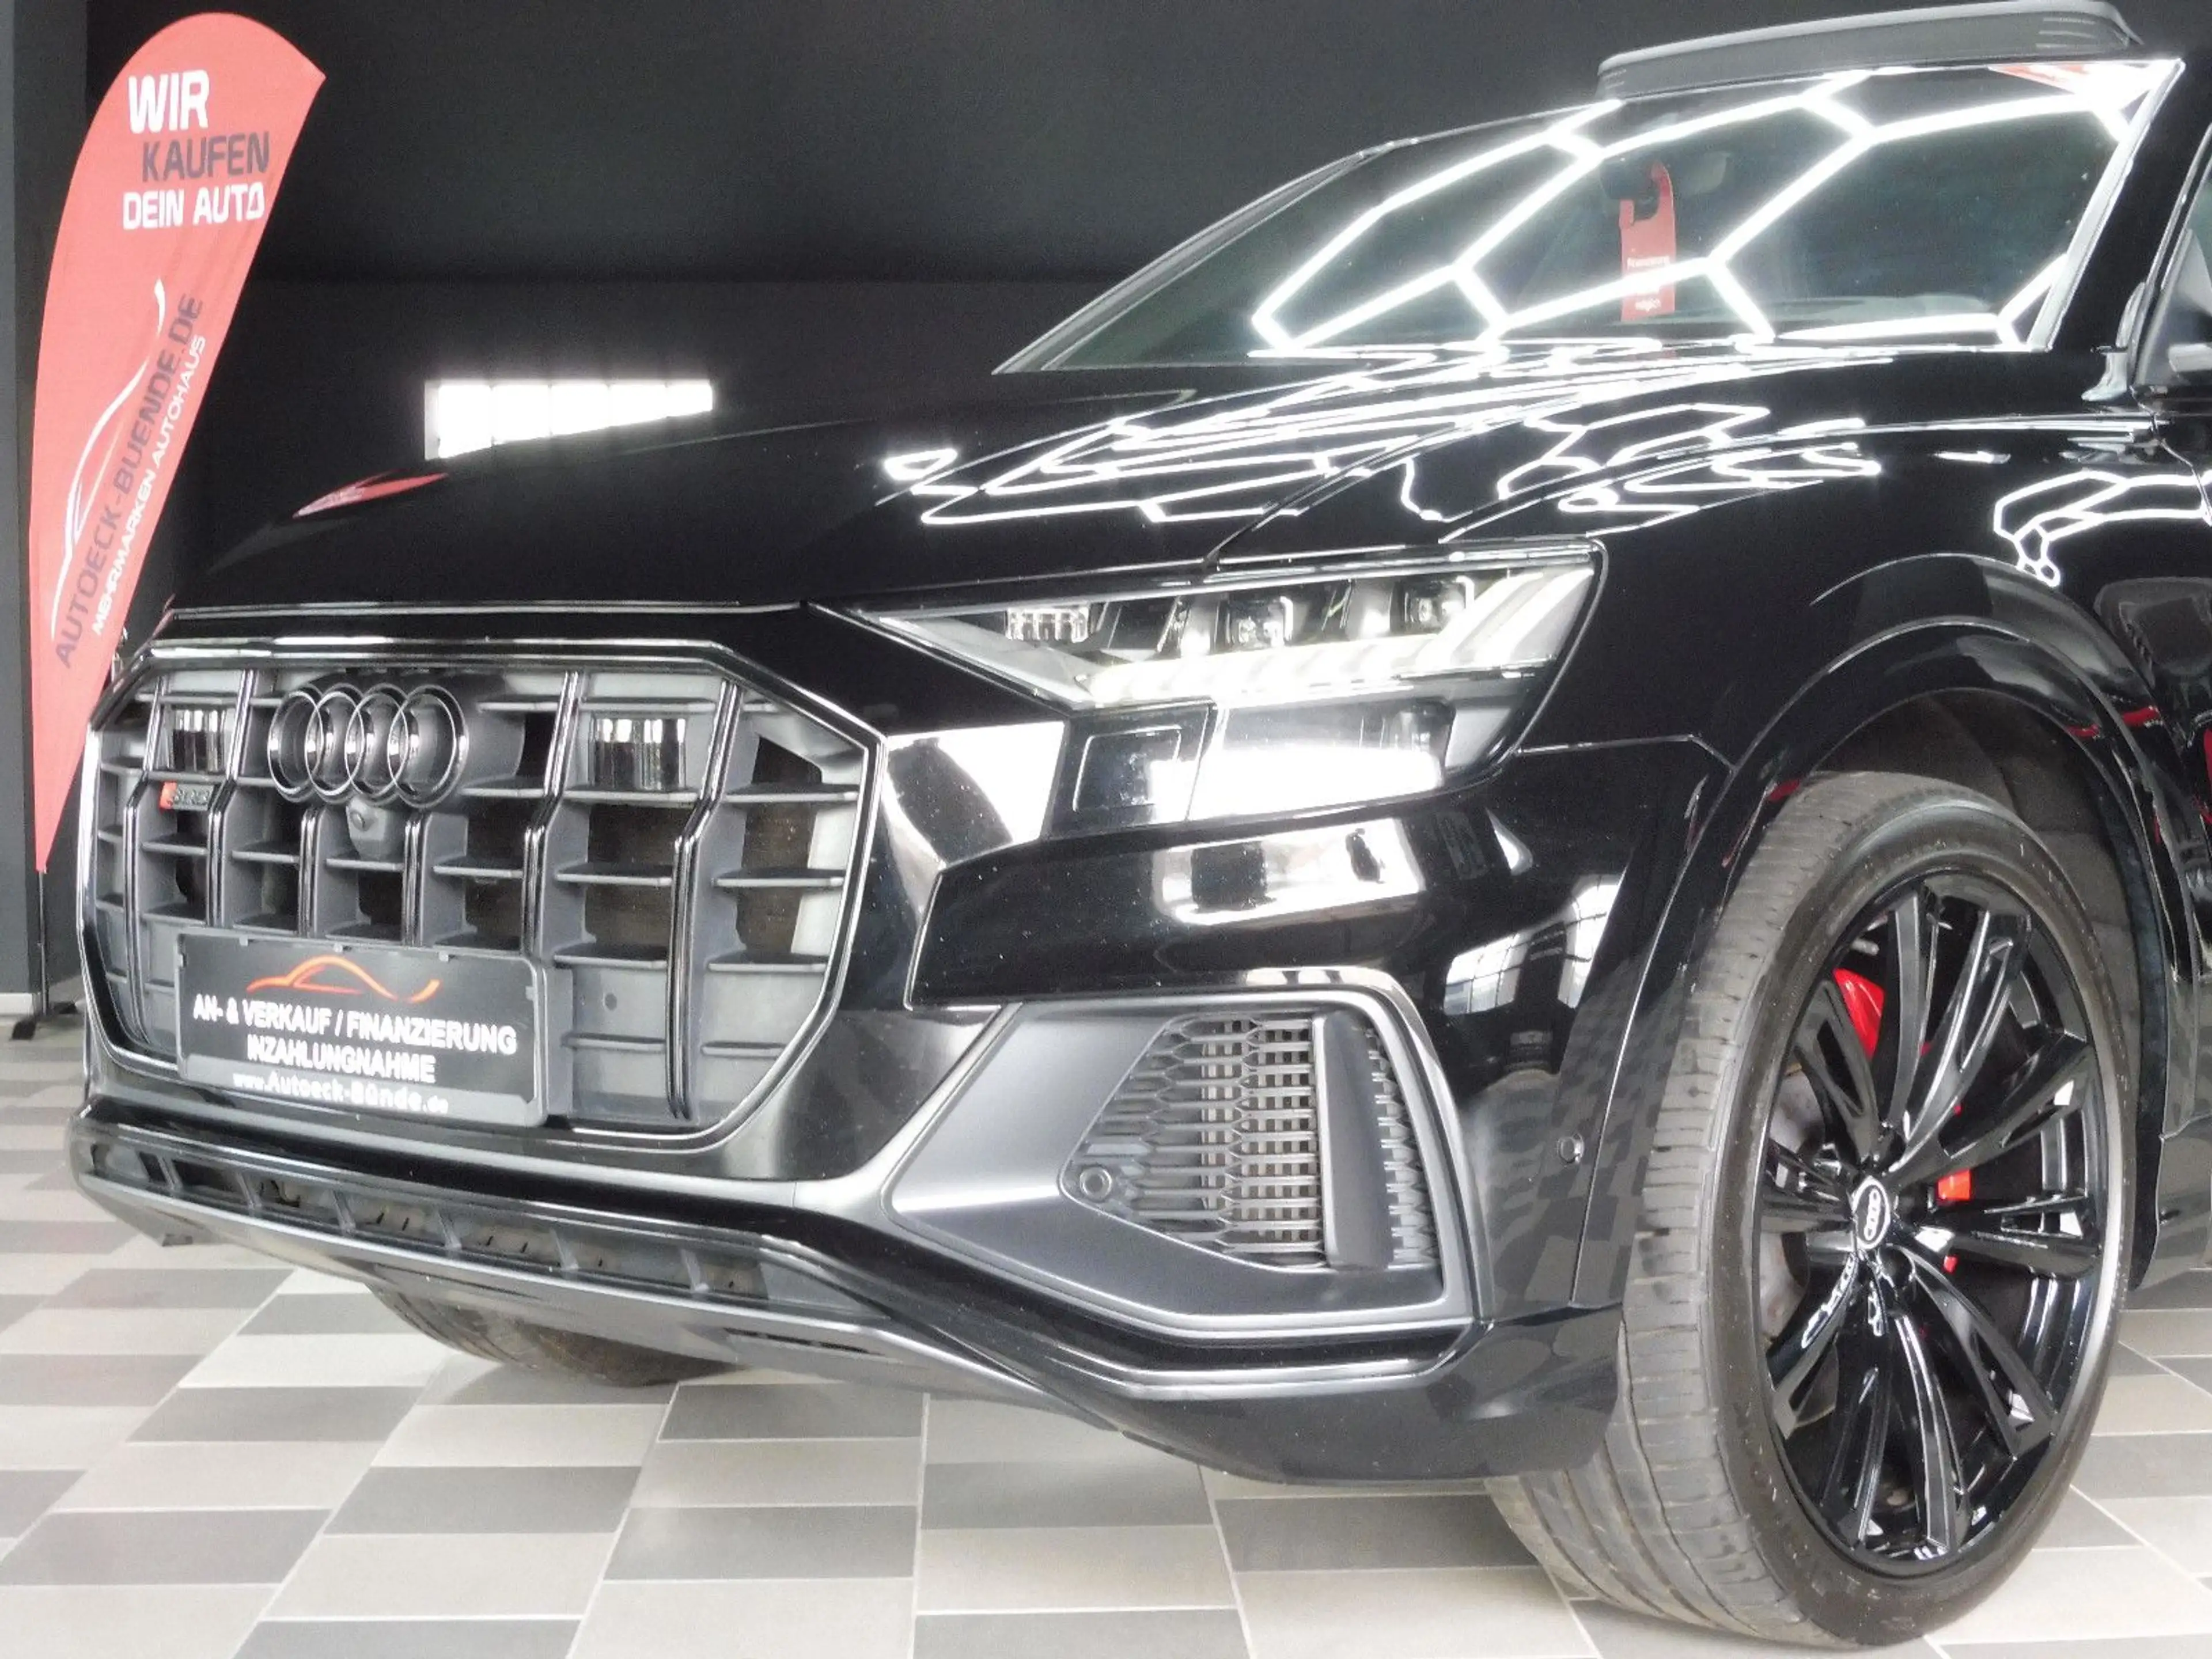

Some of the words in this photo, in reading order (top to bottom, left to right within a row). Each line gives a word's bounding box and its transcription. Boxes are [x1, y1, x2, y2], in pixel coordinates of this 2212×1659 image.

[128, 69, 210, 134] WIR
[142, 131, 270, 183] KAUFEN
[123, 189, 183, 230] DEIN
[192, 181, 264, 225] AUTO
[56, 293, 203, 669] AUTOECK-BUENDE.DE
[92, 469, 156, 635] MEHRMARKEN
[153, 335, 206, 464] AUTOHAUS
[193, 994, 223, 1023] AN-
[226, 998, 239, 1025] &
[243, 998, 332, 1036] VERKAUF
[334, 1012, 344, 1036] /
[347, 1013, 517, 1055] FINANZIERUNG
[247, 1034, 436, 1083] INZAHLUNGNAHME
